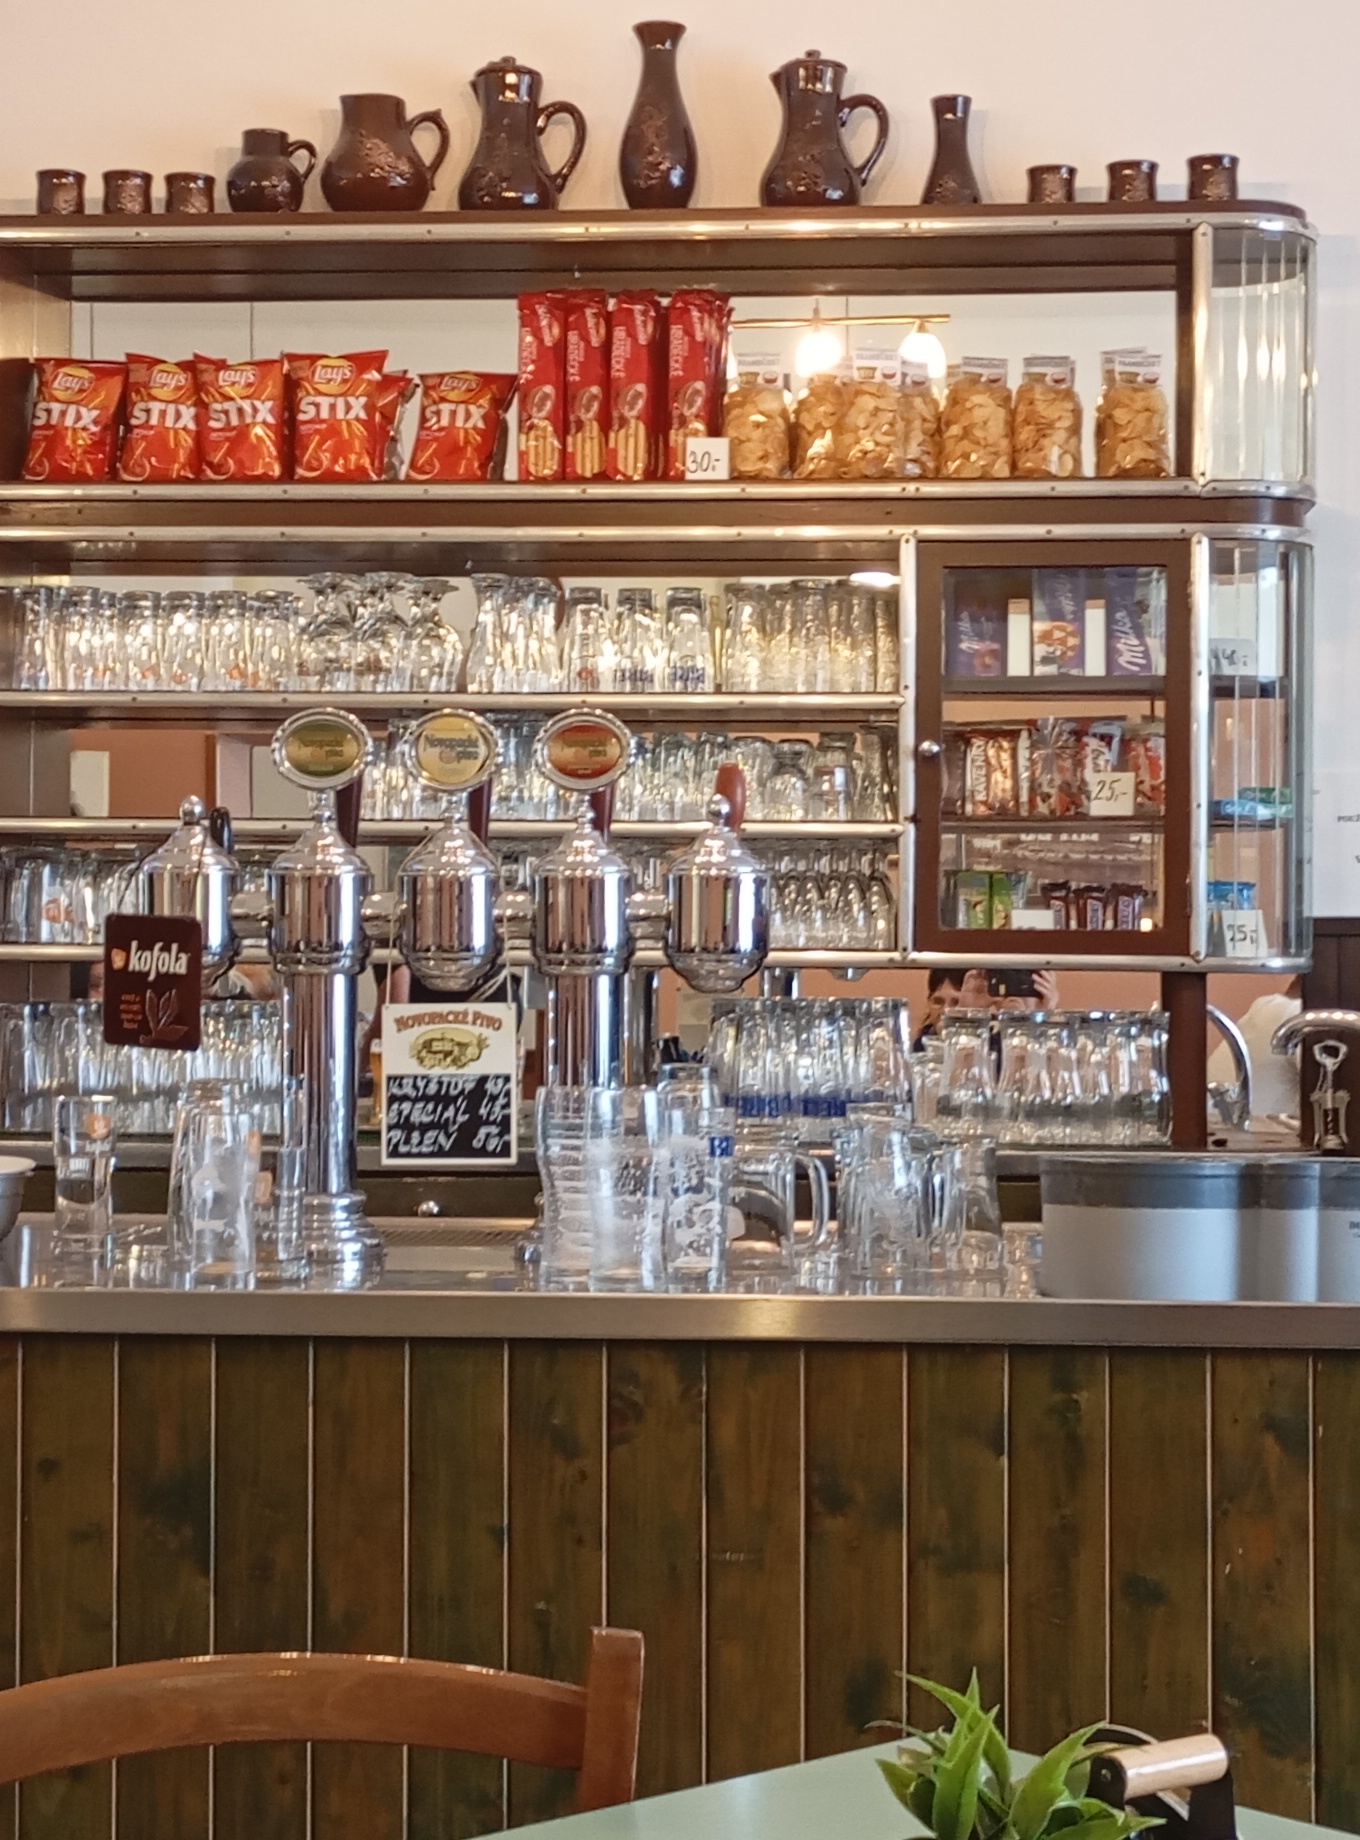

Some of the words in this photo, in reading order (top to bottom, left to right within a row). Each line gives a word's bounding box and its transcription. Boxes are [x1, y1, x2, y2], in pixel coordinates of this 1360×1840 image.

[32, 401, 100, 431] STIX
[130, 401, 197, 430] STIX
[208, 400, 276, 429] STIX
[296, 396, 368, 421] STIX
[423, 403, 489, 430] STIX
[1110, 607, 1147, 671] Milka
[128, 939, 189, 983] kofola
[394, 1008, 470, 1033] NOVOPACKÉ
[471, 1009, 503, 1032] PIVO
